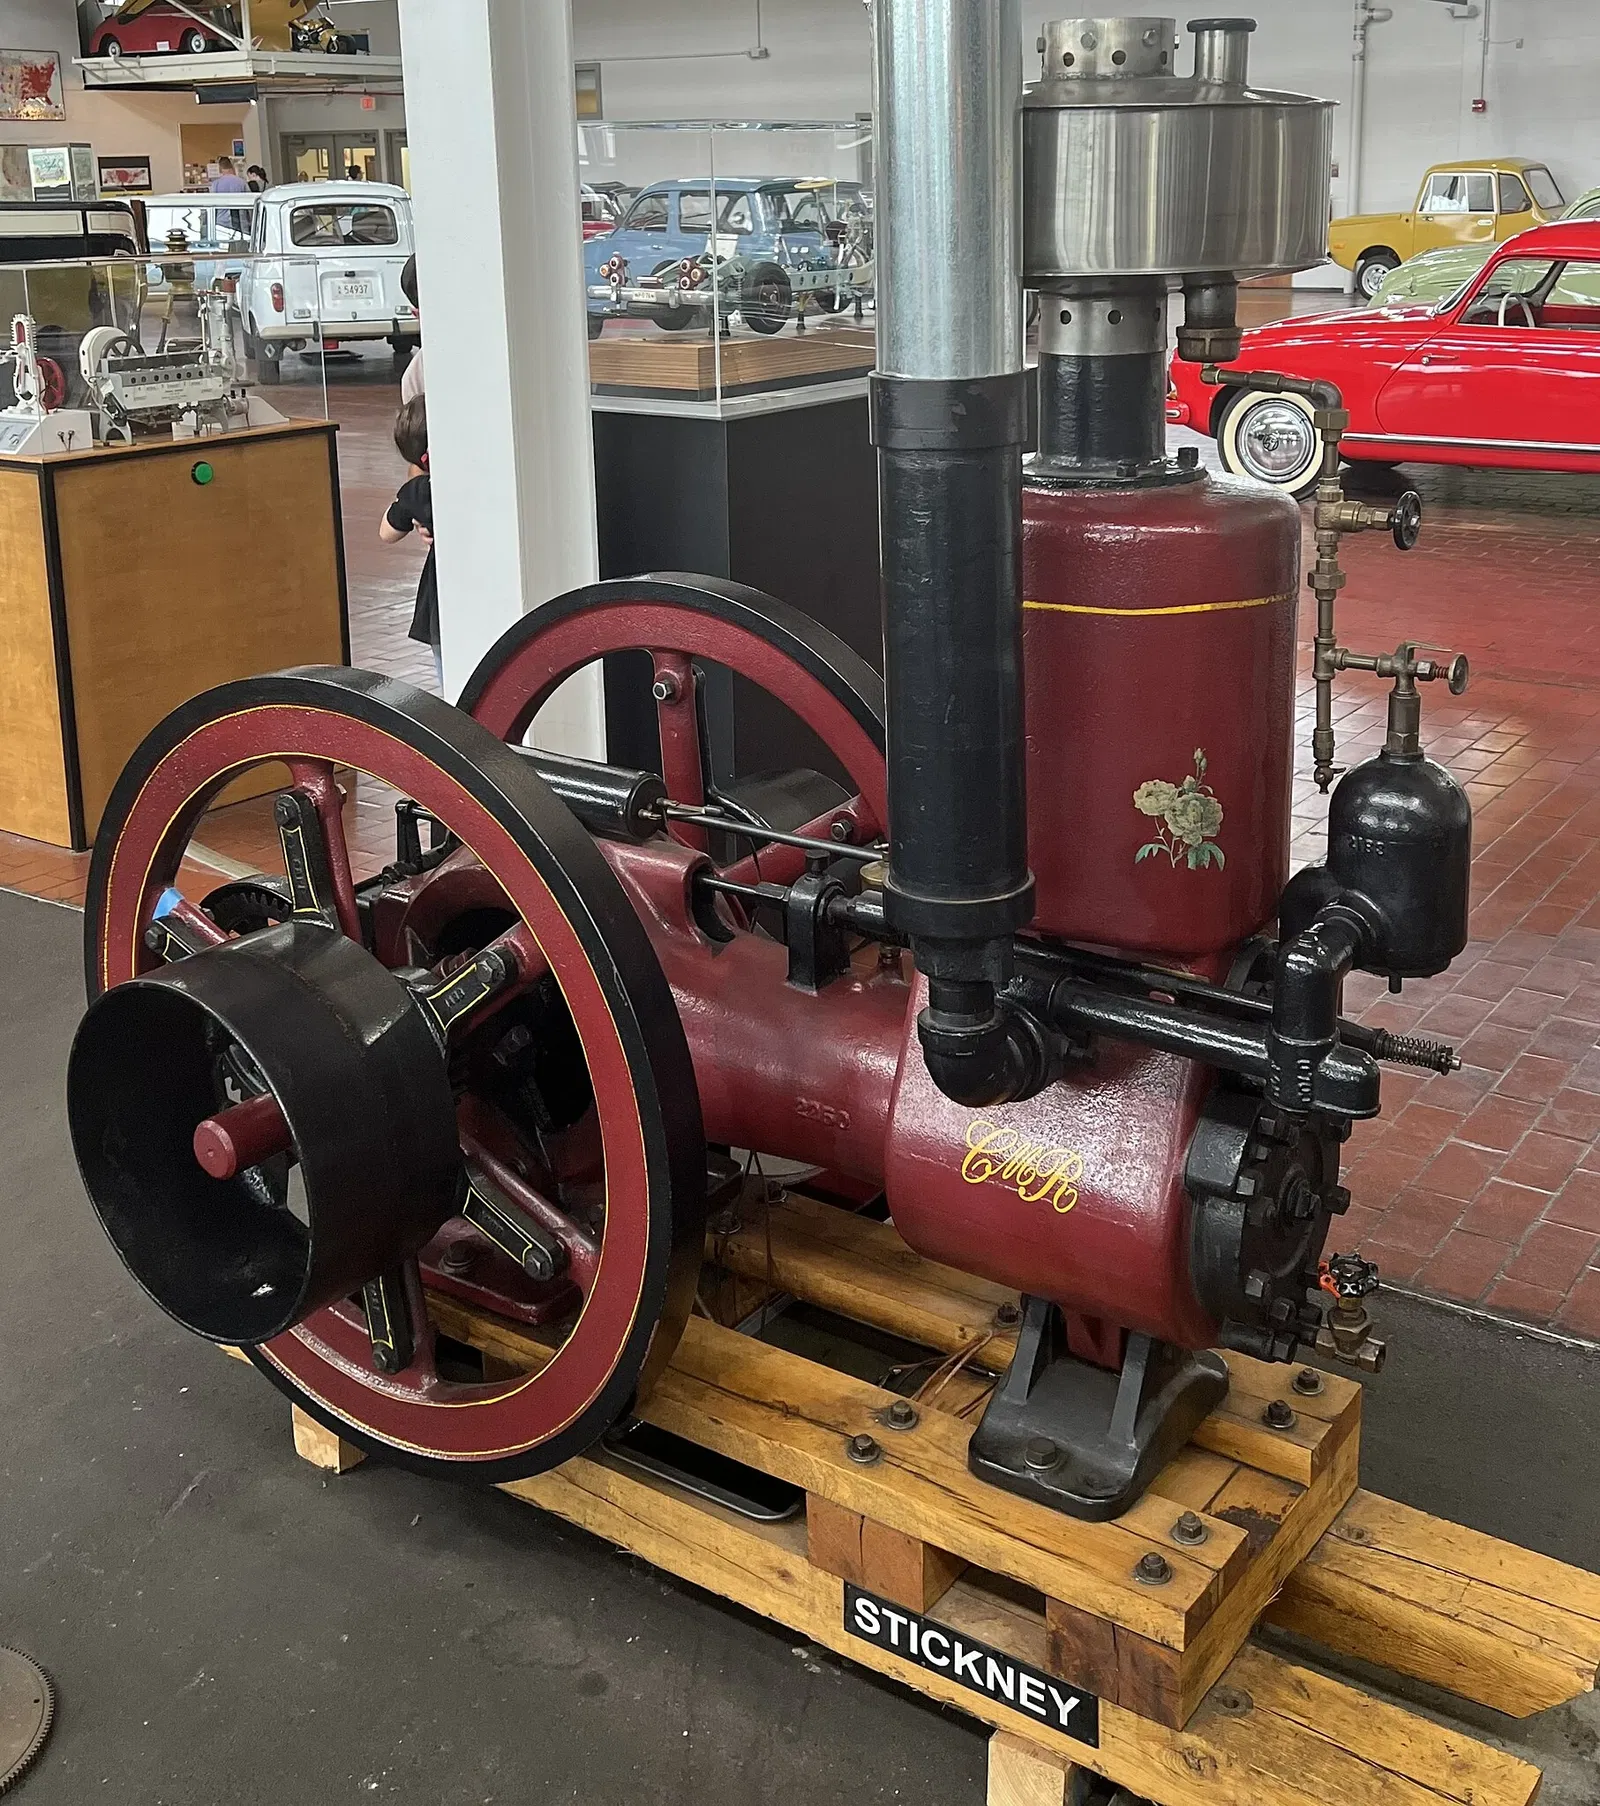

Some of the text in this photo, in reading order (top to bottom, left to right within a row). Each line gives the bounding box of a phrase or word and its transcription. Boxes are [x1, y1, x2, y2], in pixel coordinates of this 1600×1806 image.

[344, 285, 368, 294] 54937
[961, 1120, 1085, 1214] CMR
[853, 1597, 1081, 1727] STICKNEY
